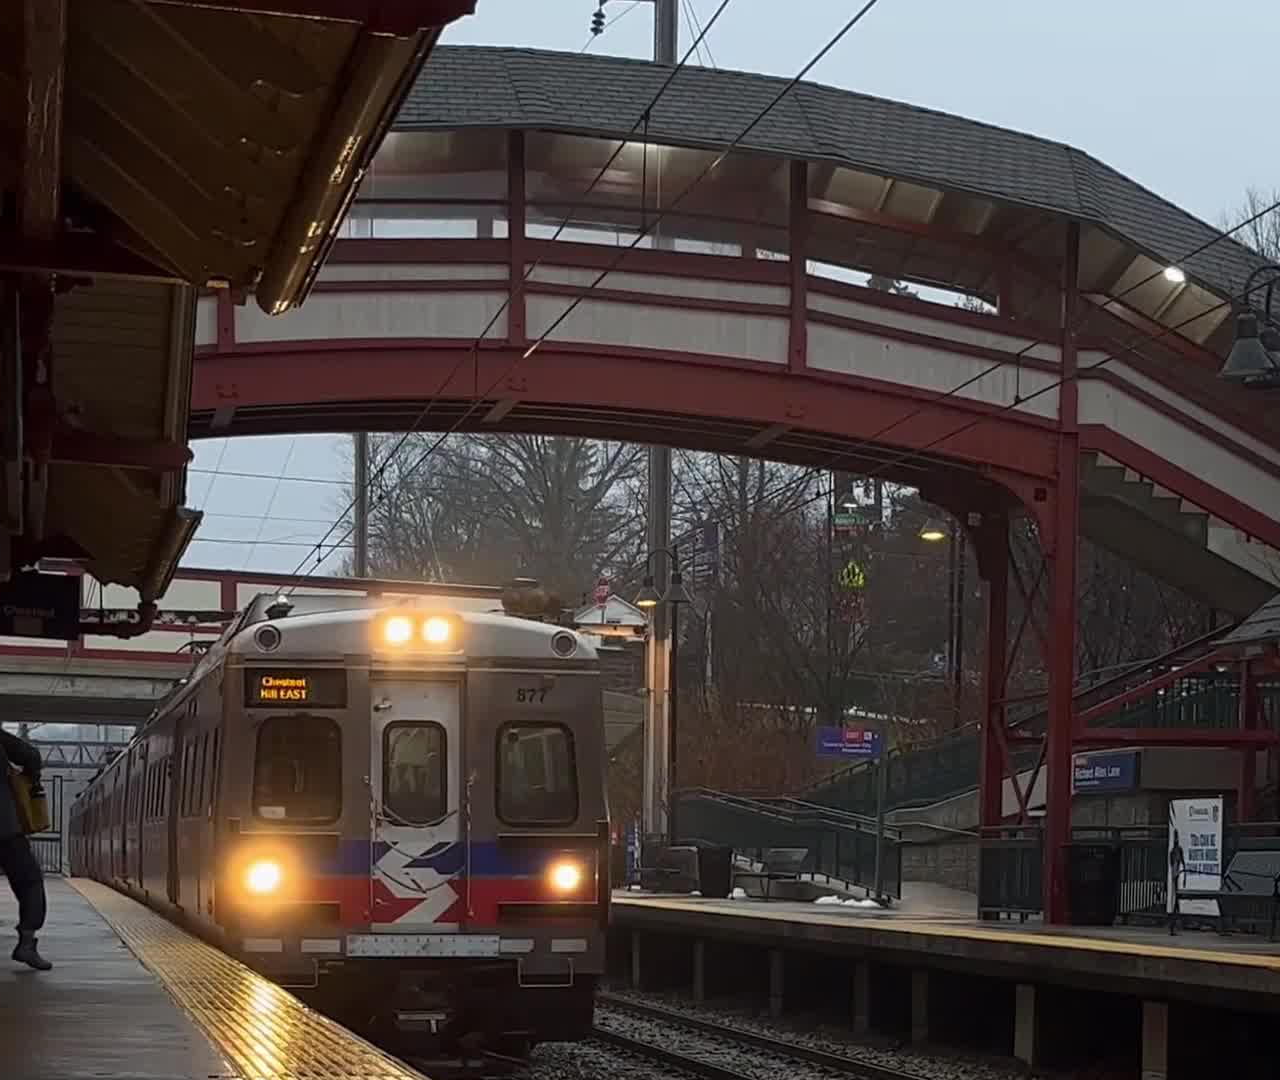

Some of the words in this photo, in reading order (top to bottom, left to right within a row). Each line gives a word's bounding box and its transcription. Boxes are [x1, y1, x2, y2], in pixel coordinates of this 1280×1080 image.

[260, 689, 278, 699] Hill
[279, 689, 307, 699] EAST
[517, 688, 546, 704] 877
